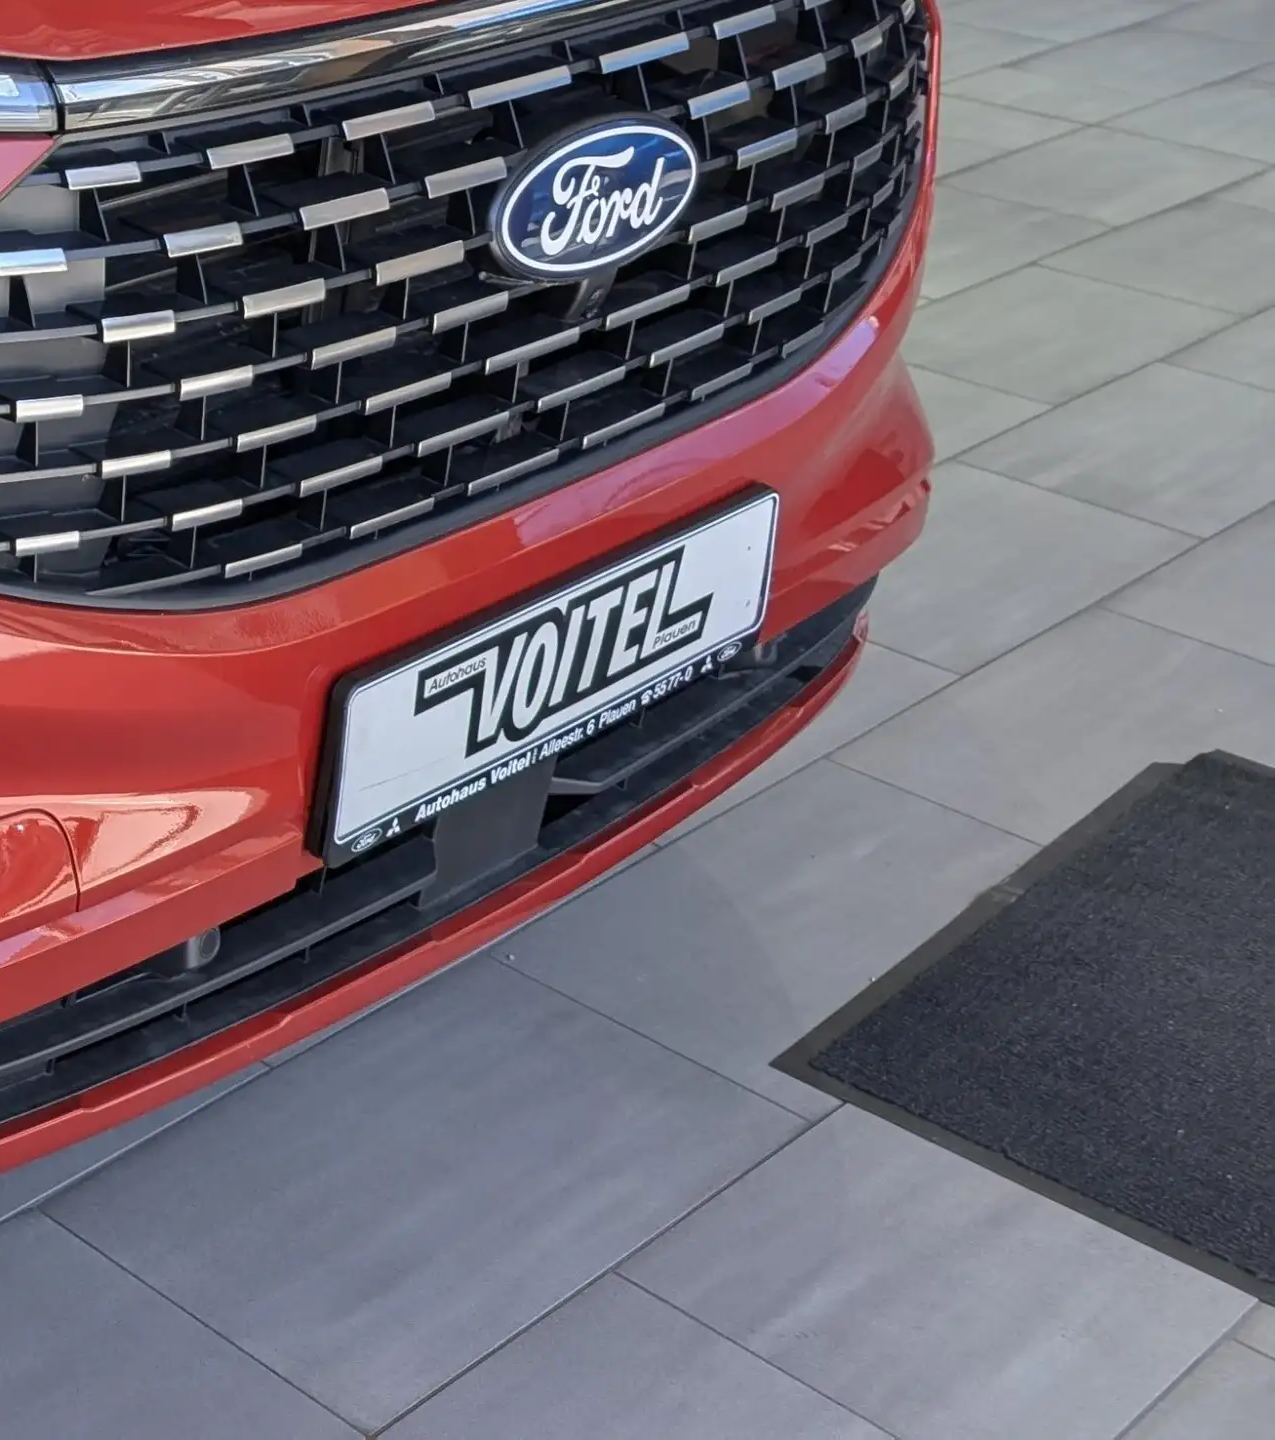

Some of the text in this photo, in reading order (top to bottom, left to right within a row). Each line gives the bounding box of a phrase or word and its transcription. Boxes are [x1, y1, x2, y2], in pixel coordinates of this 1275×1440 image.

[540, 146, 666, 256] Ford
[428, 657, 487, 694] Autohaus
[475, 558, 681, 744] VOITEL
[652, 619, 697, 650] Plauen
[414, 777, 487, 822] Autohaus
[490, 751, 531, 784] Voitel
[539, 727, 585, 760] Alleestr.
[586, 718, 596, 736] 6
[598, 698, 636, 729] Plauen
